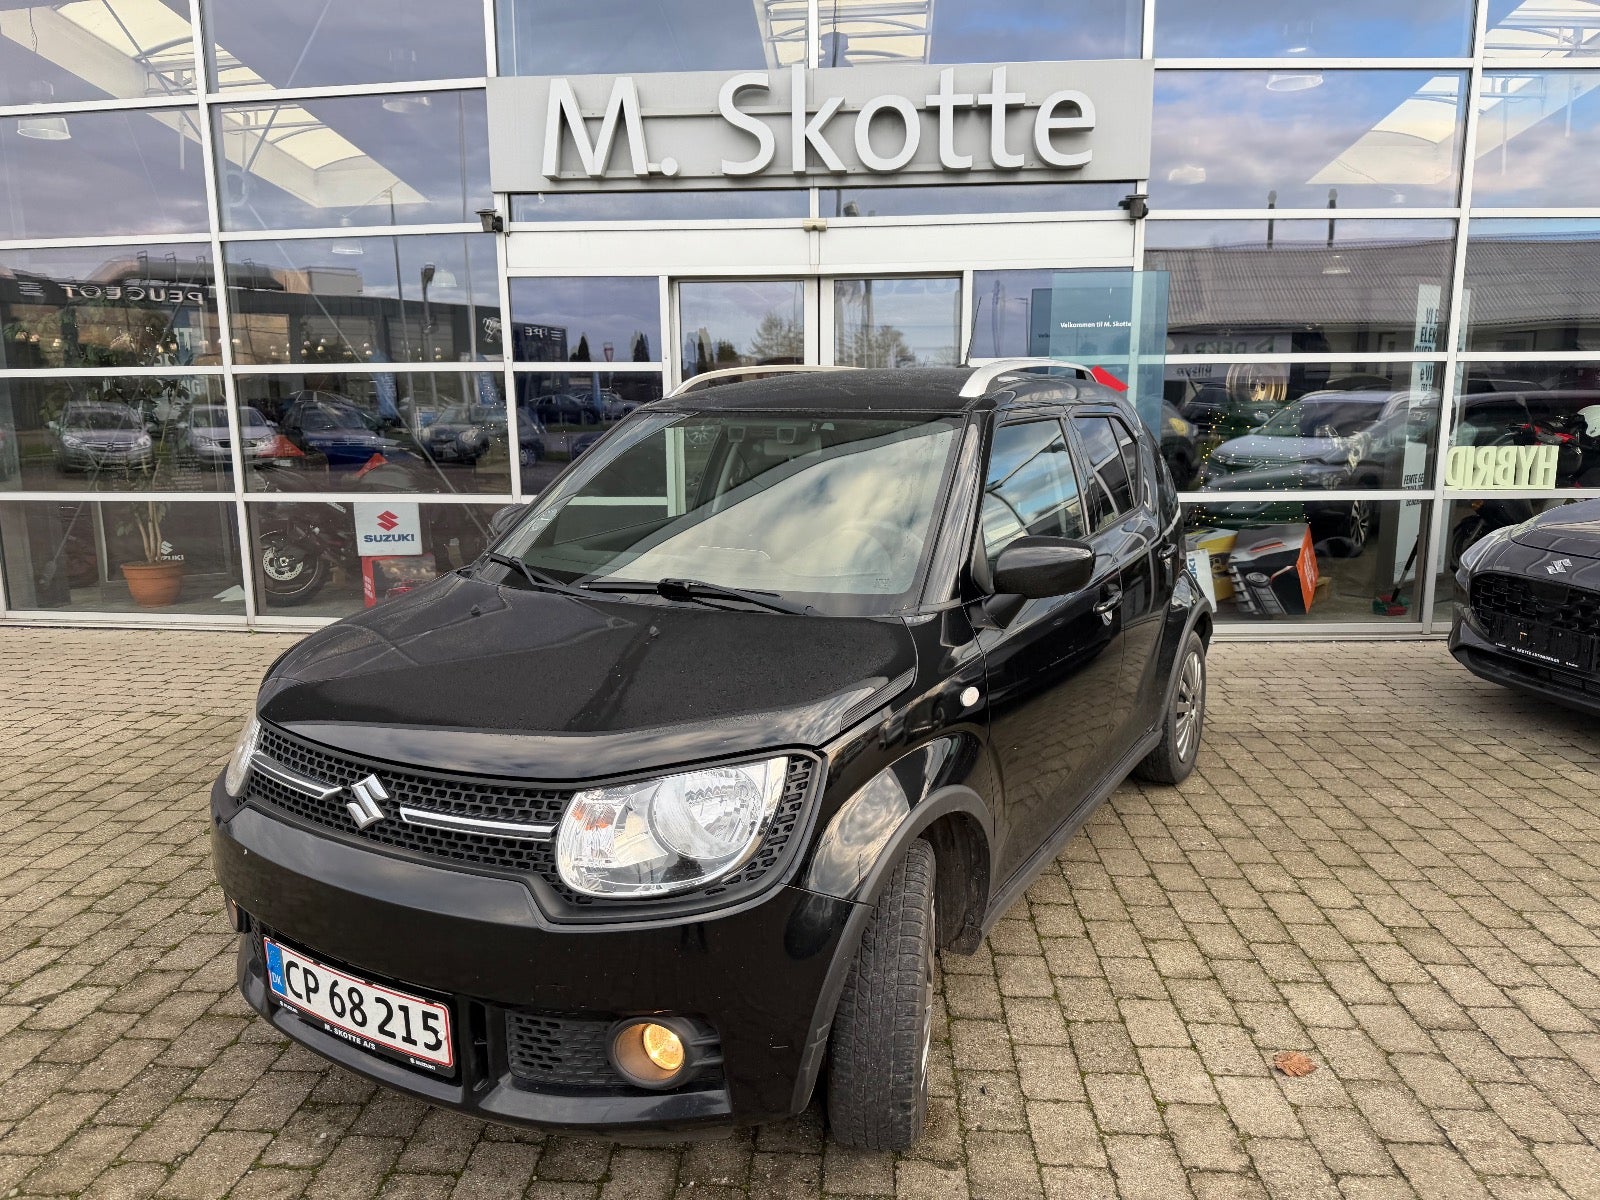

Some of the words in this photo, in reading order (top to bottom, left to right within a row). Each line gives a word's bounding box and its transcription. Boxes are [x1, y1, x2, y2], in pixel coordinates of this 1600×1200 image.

[541, 77, 680, 180] M.
[719, 64, 1097, 177] Skotte
[1060, 321, 1096, 329] Velkommen
[1112, 320, 1132, 328] Skotte
[364, 533, 415, 542] SUZUKI
[1188, 557, 1198, 579] UKI
[272, 972, 282, 986] DK
[285, 960, 319, 1004] CP
[329, 979, 368, 1028] 68
[374, 996, 443, 1051] 215
[324, 1023, 333, 1032] M.
[333, 1027, 361, 1045] SKOTTE
[363, 1038, 376, 1050] A/S
